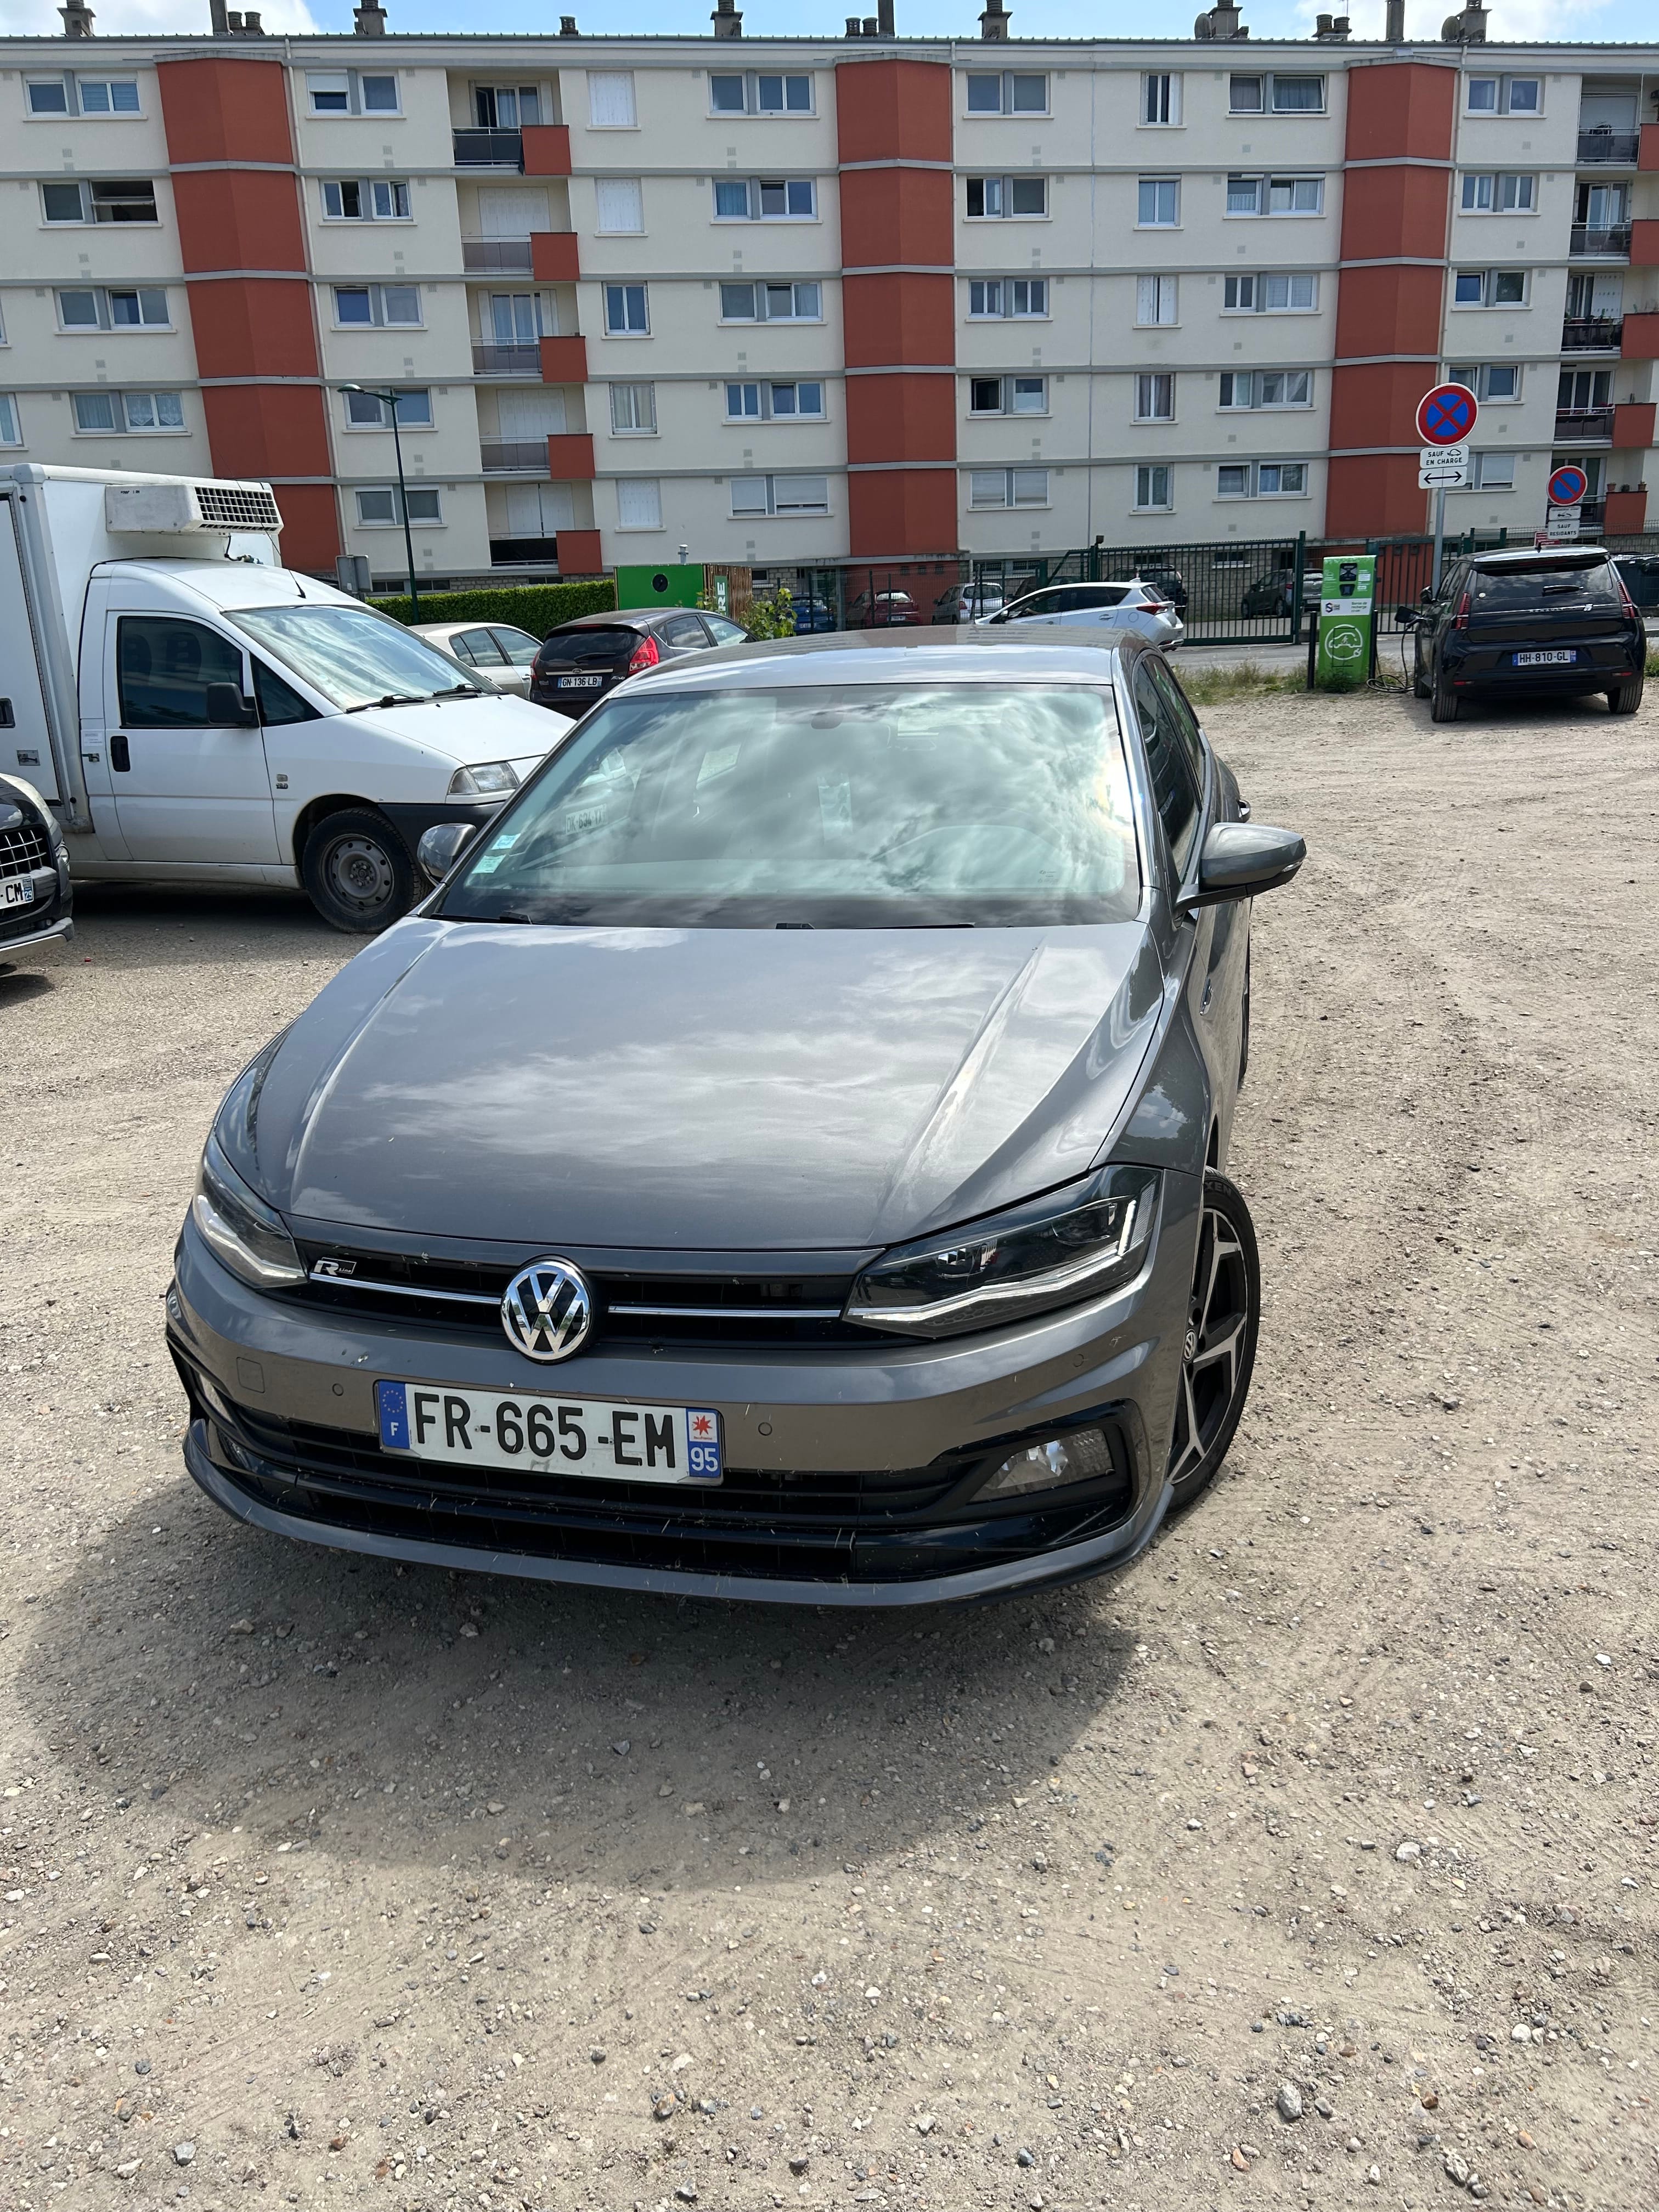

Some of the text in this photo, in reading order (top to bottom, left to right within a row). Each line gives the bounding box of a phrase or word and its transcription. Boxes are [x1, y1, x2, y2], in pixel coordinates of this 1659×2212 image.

[717, 582, 726, 615] RE
[1519, 651, 1568, 663] HH-810-GL
[25, 890, 32, 900] 29
[313, 1260, 338, 1276] R
[391, 1421, 399, 1436] F
[414, 1392, 676, 1468] FR-665-EM
[691, 1447, 719, 1472] 95
